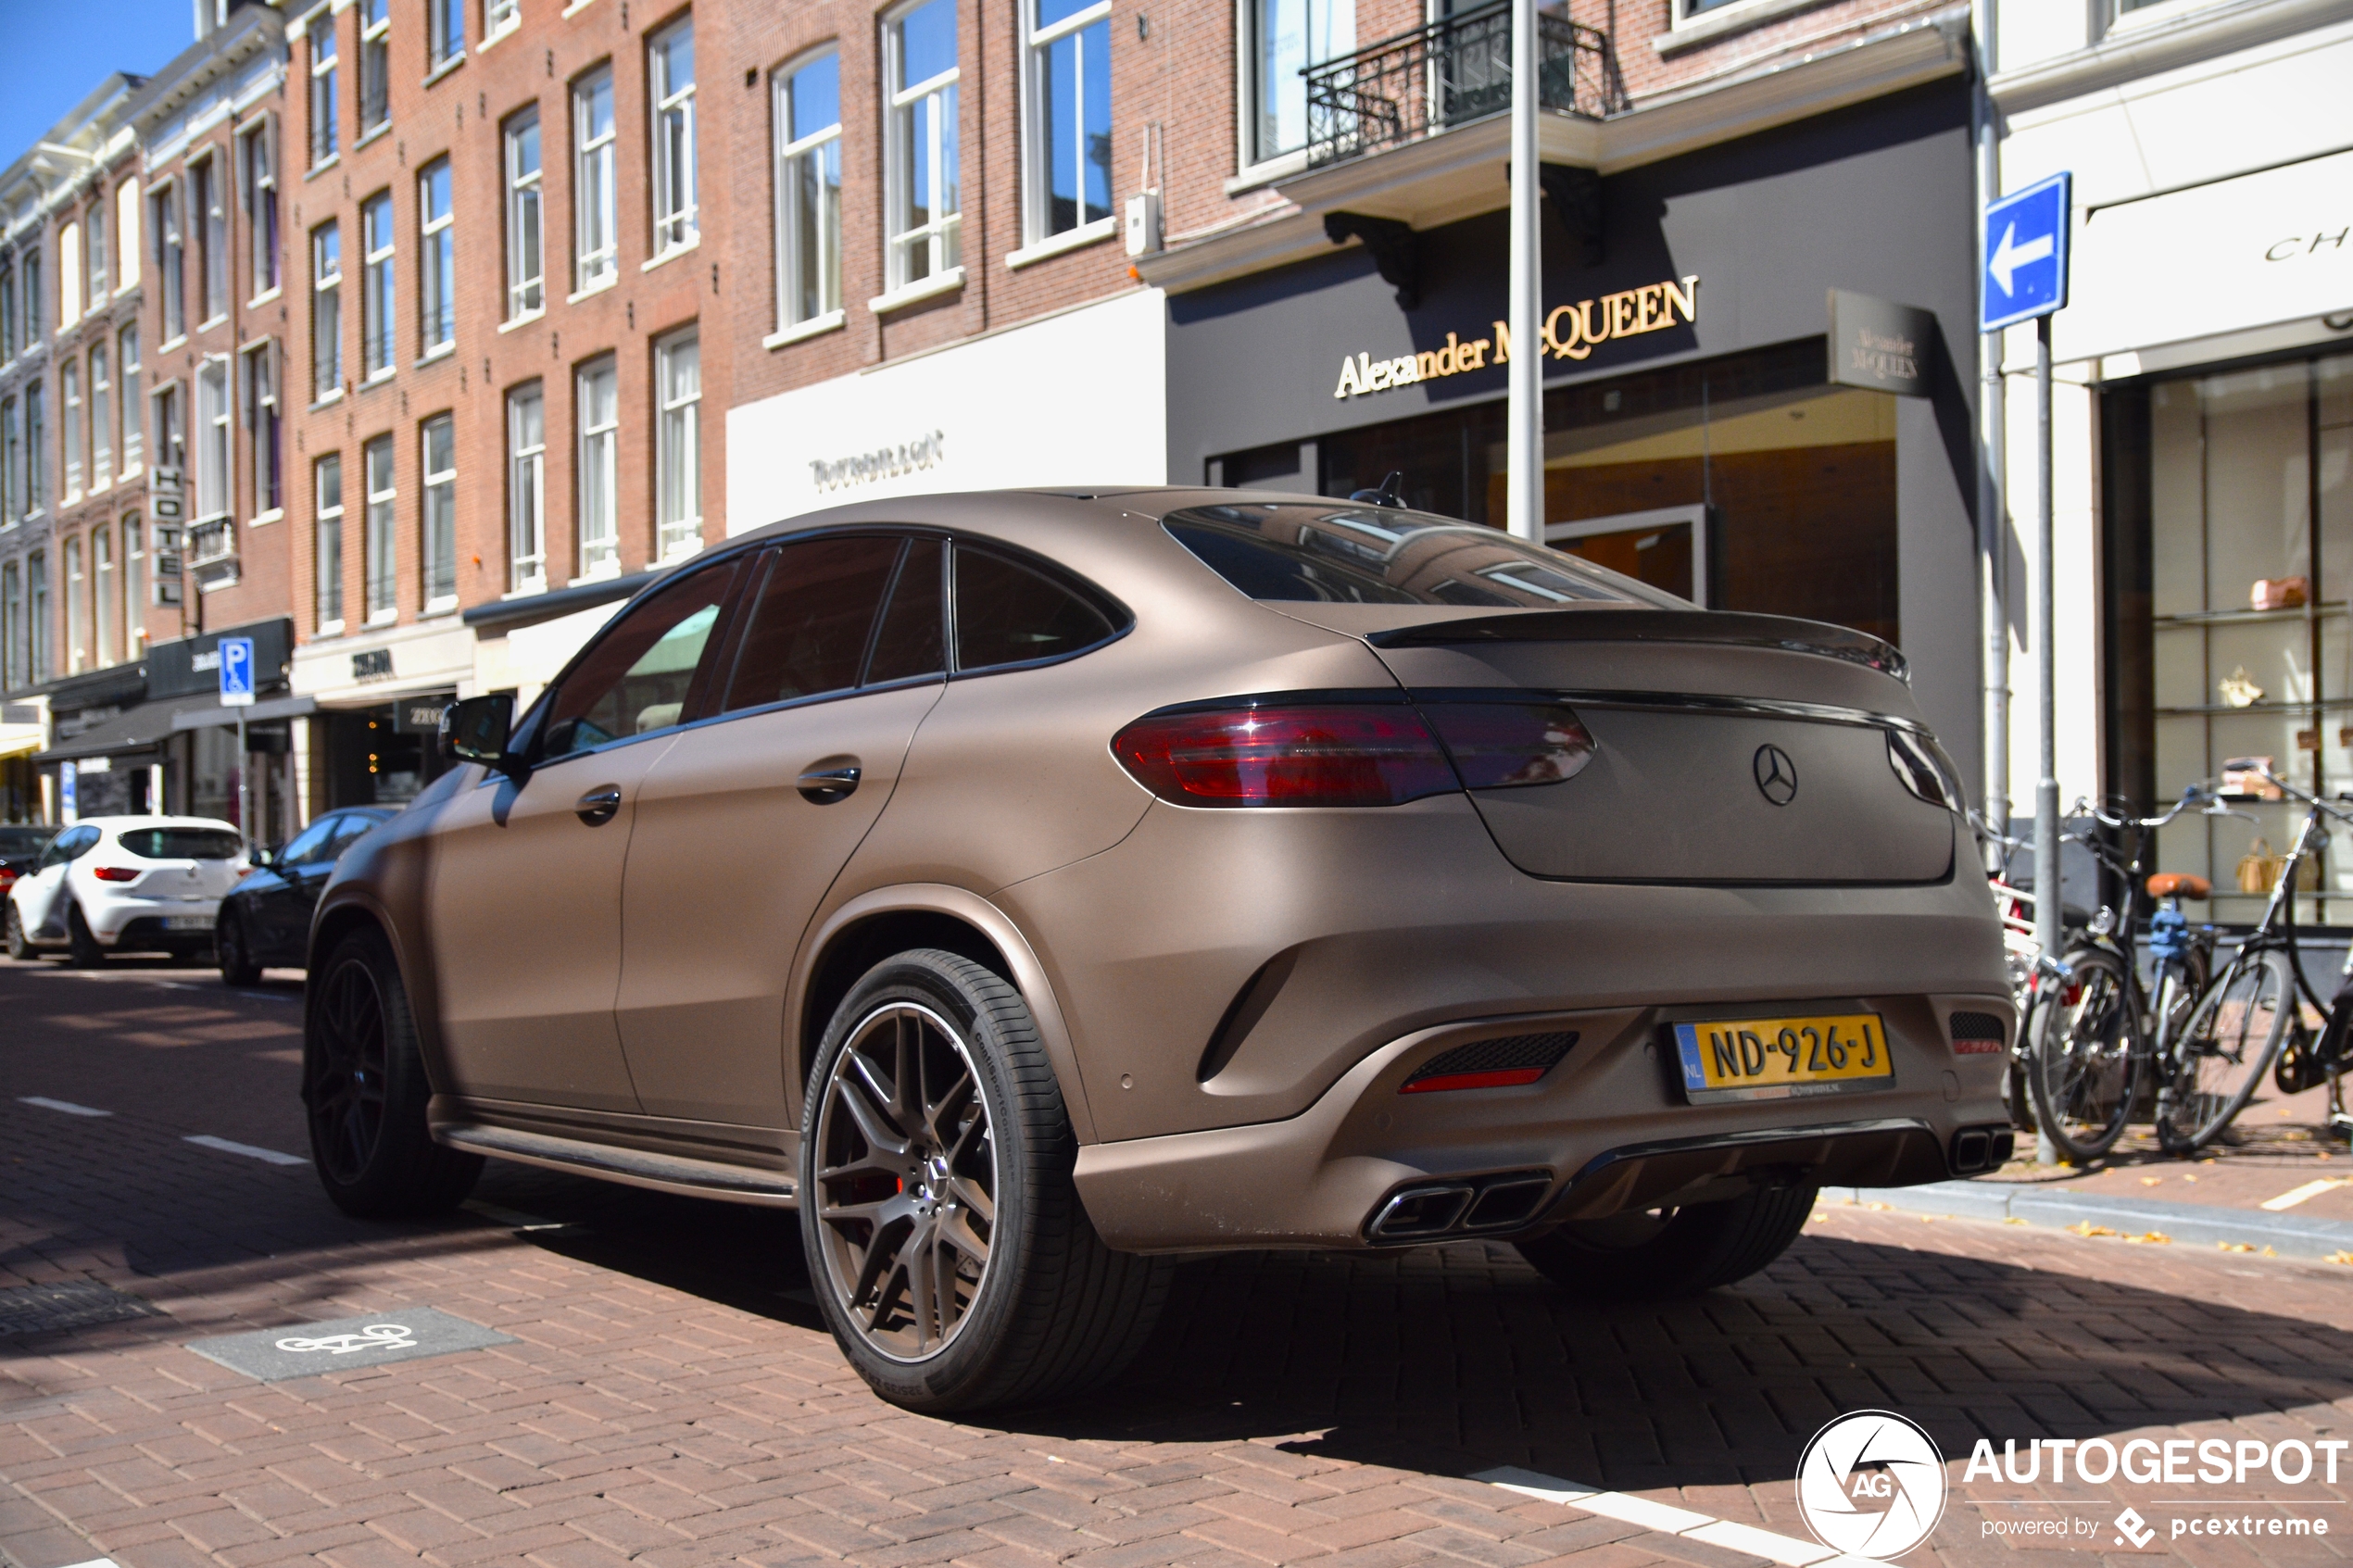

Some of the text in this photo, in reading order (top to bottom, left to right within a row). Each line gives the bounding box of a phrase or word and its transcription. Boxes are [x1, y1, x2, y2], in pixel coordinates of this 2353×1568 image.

[2265, 226, 2353, 262] CH
[1334, 331, 1491, 398] Alexander
[156, 469, 180, 604] HOTEL
[226, 645, 247, 673] P
[1683, 1064, 1701, 1078] NL
[1710, 1023, 1876, 1077] ND-926-J
